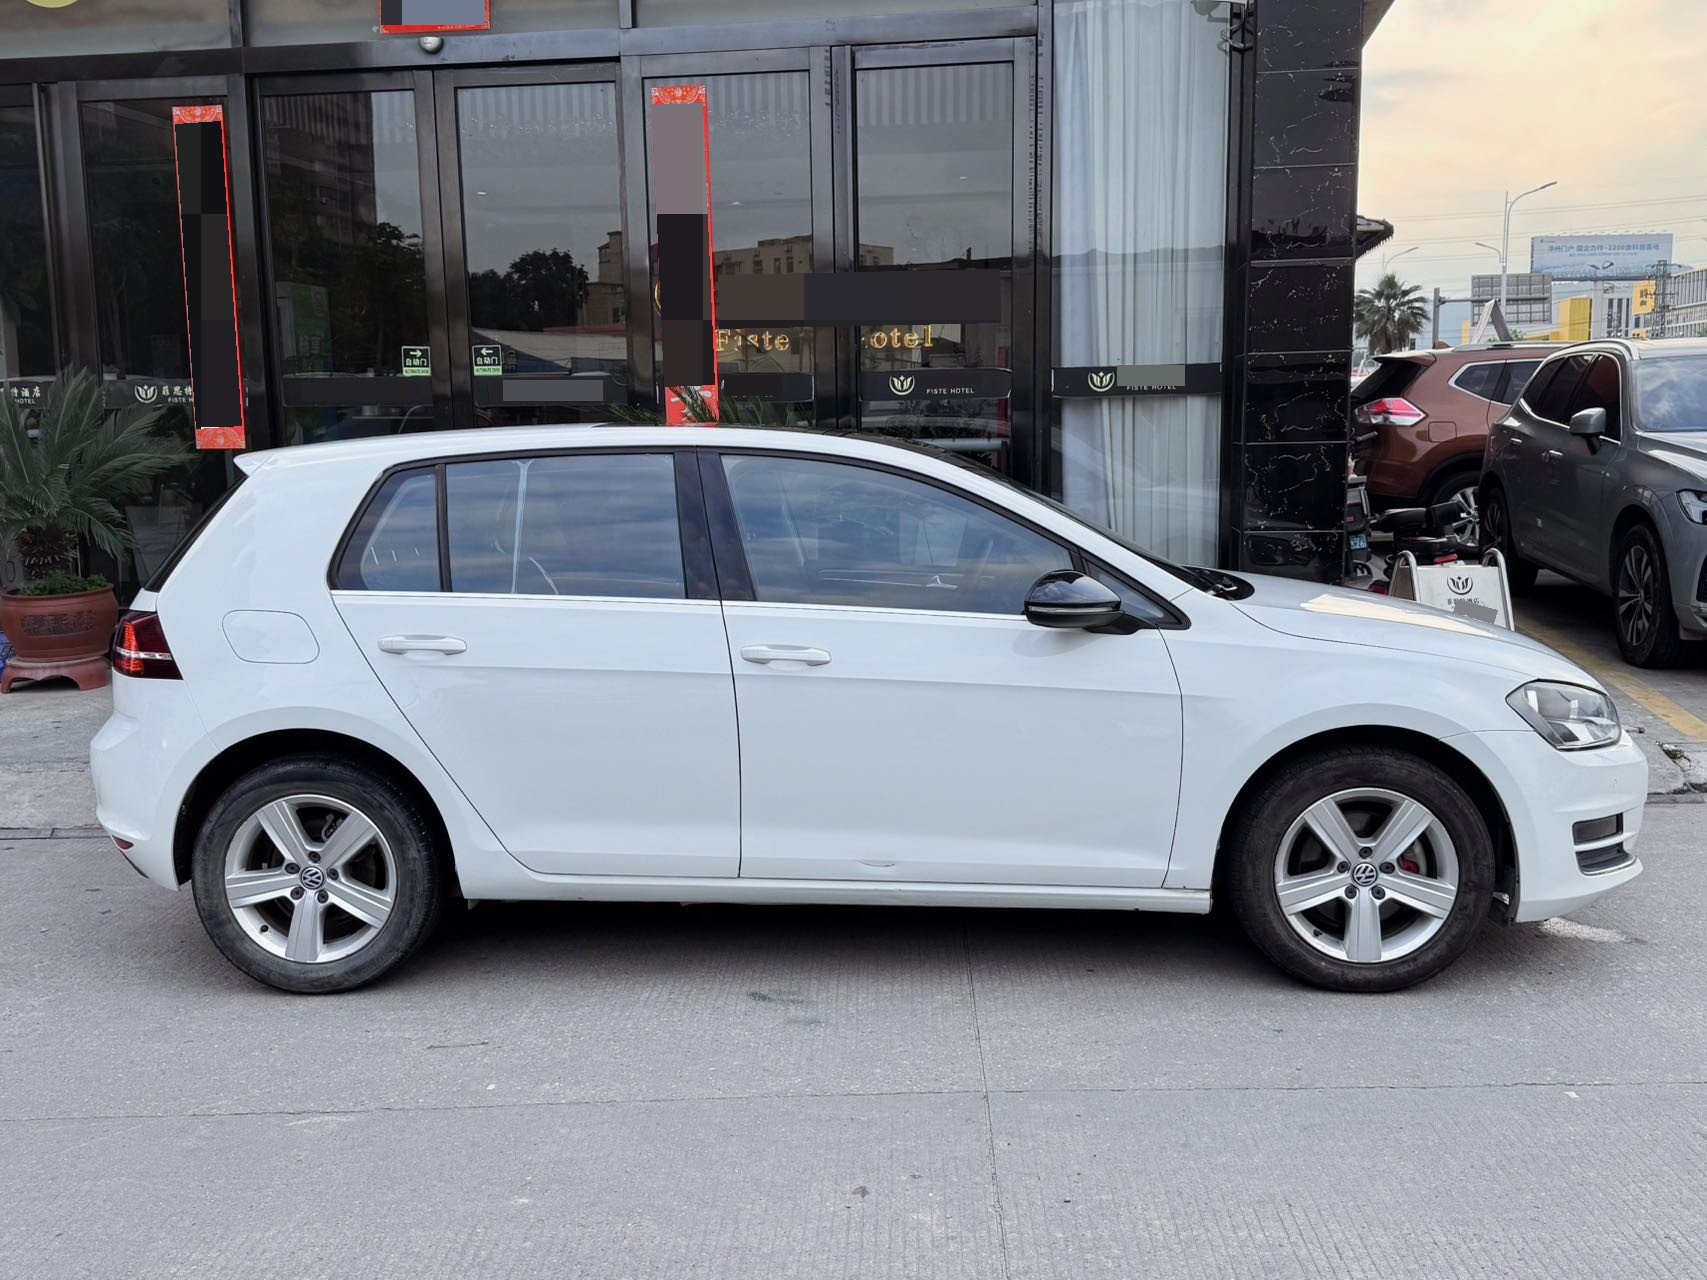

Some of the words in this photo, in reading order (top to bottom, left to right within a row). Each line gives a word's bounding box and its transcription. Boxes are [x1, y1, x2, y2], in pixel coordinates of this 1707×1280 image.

[861, 323, 934, 349] otel
[405, 357, 427, 367] 自动门
[476, 356, 498, 365] 自动门
[926, 387, 947, 395] FISTE
